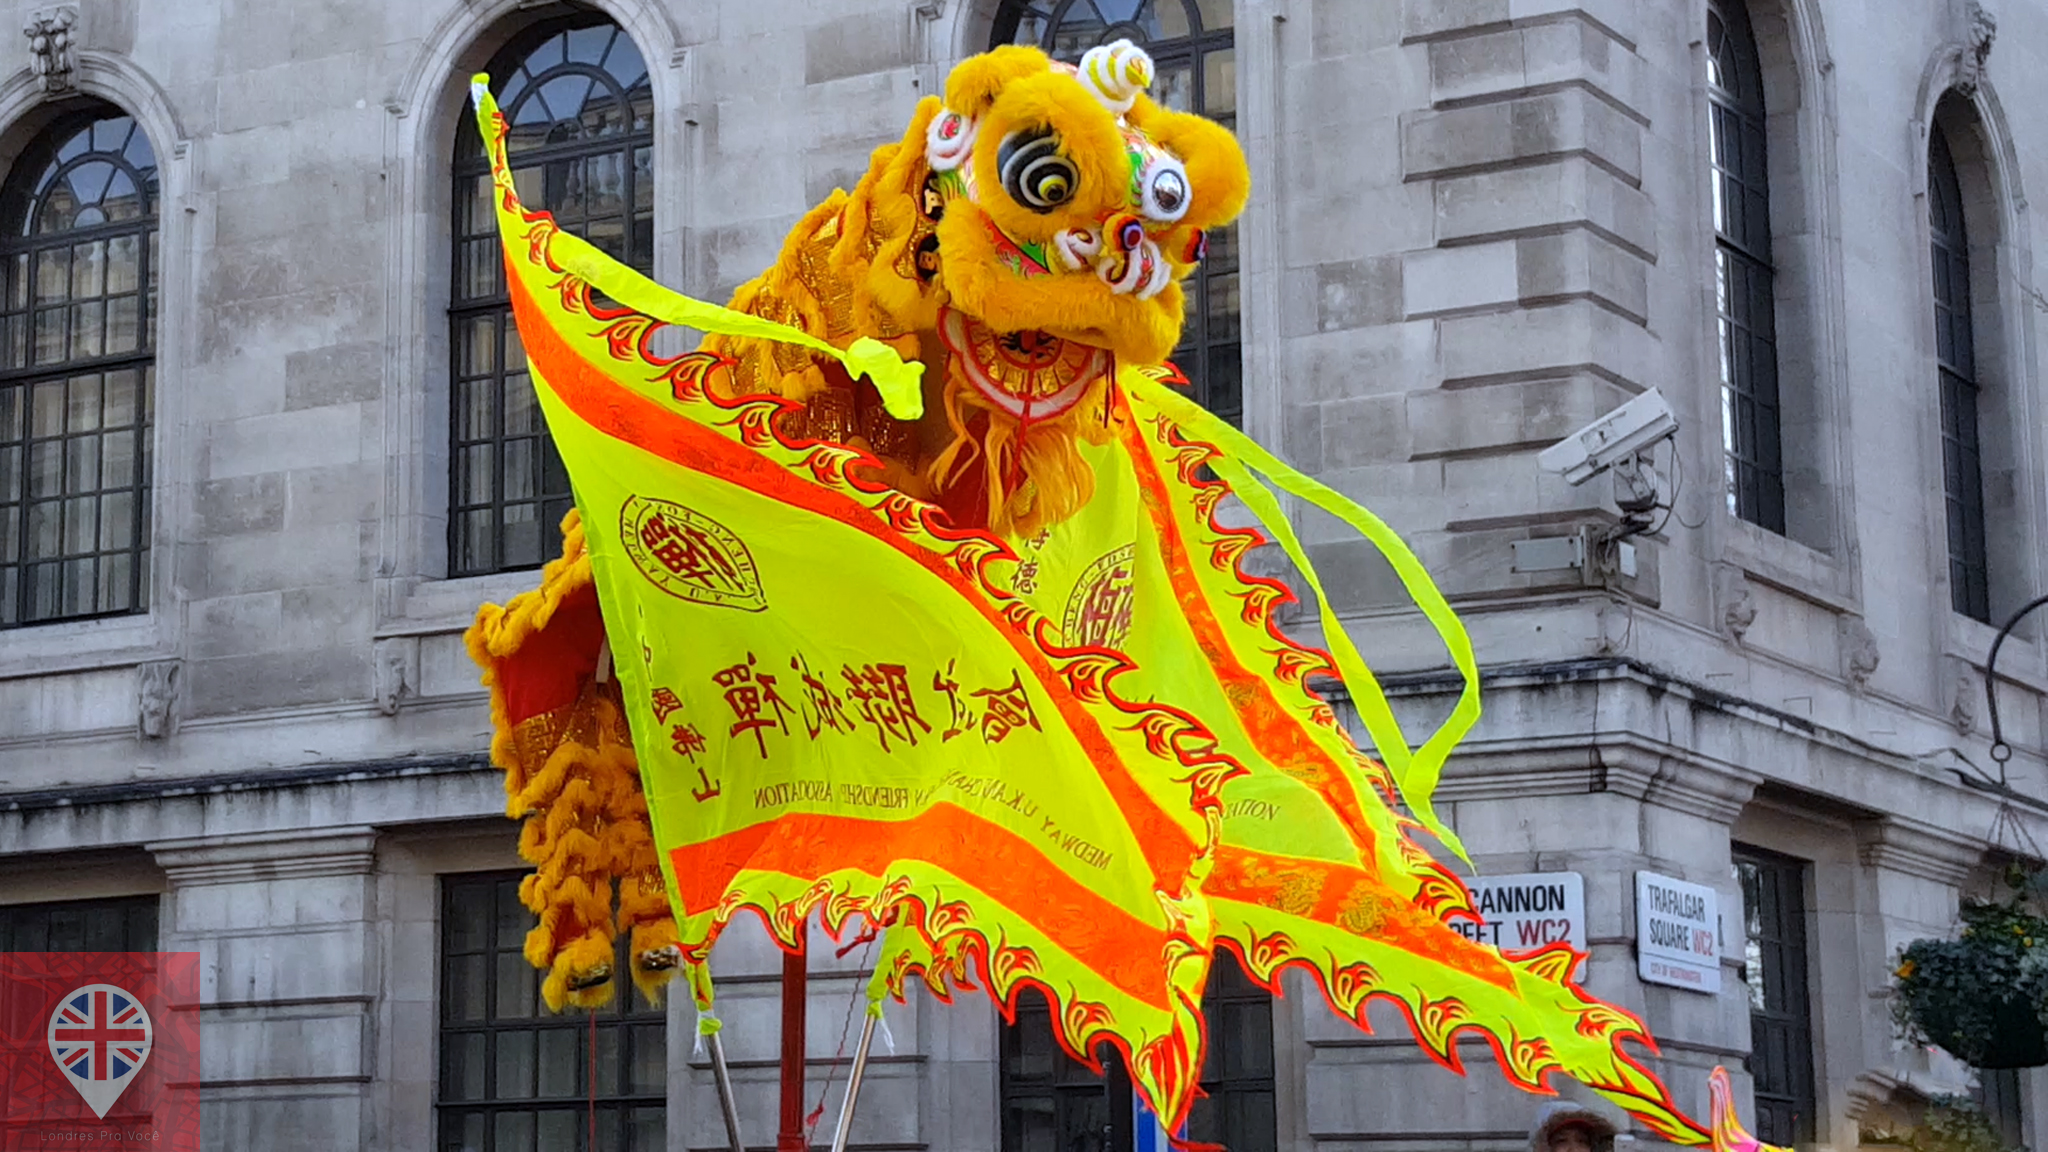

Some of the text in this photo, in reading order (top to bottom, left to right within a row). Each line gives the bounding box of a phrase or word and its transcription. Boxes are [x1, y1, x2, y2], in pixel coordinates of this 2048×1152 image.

[1647, 884, 1706, 923] TRAFALGAR
[1516, 919, 1572, 947] WC2
[1649, 917, 1714, 957] SQUARE WC2
